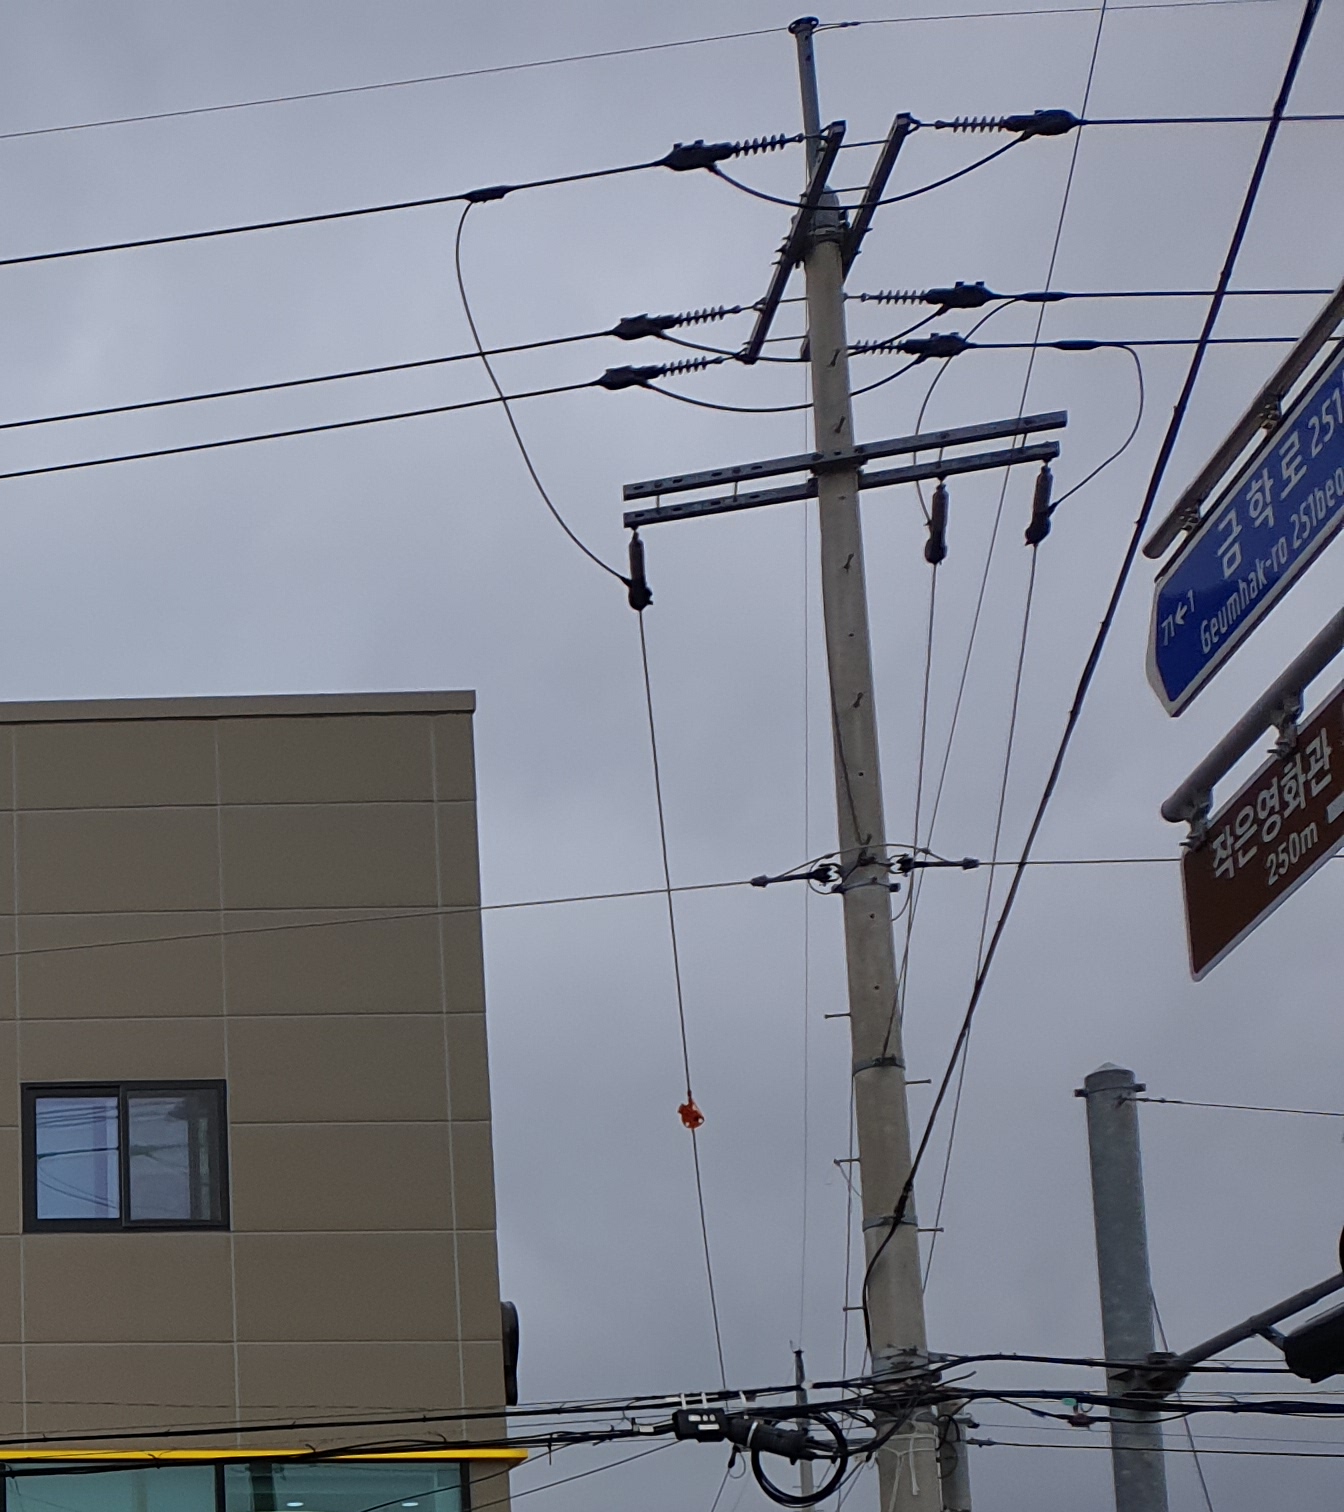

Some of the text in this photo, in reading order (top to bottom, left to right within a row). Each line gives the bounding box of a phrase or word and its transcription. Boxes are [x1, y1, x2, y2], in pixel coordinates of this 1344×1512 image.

[1217, 430, 1308, 580] 금학로
[1200, 535, 1289, 656] Geumhak-ro
[1212, 727, 1333, 879] 작은영화관
[1265, 821, 1319, 887] 250m
